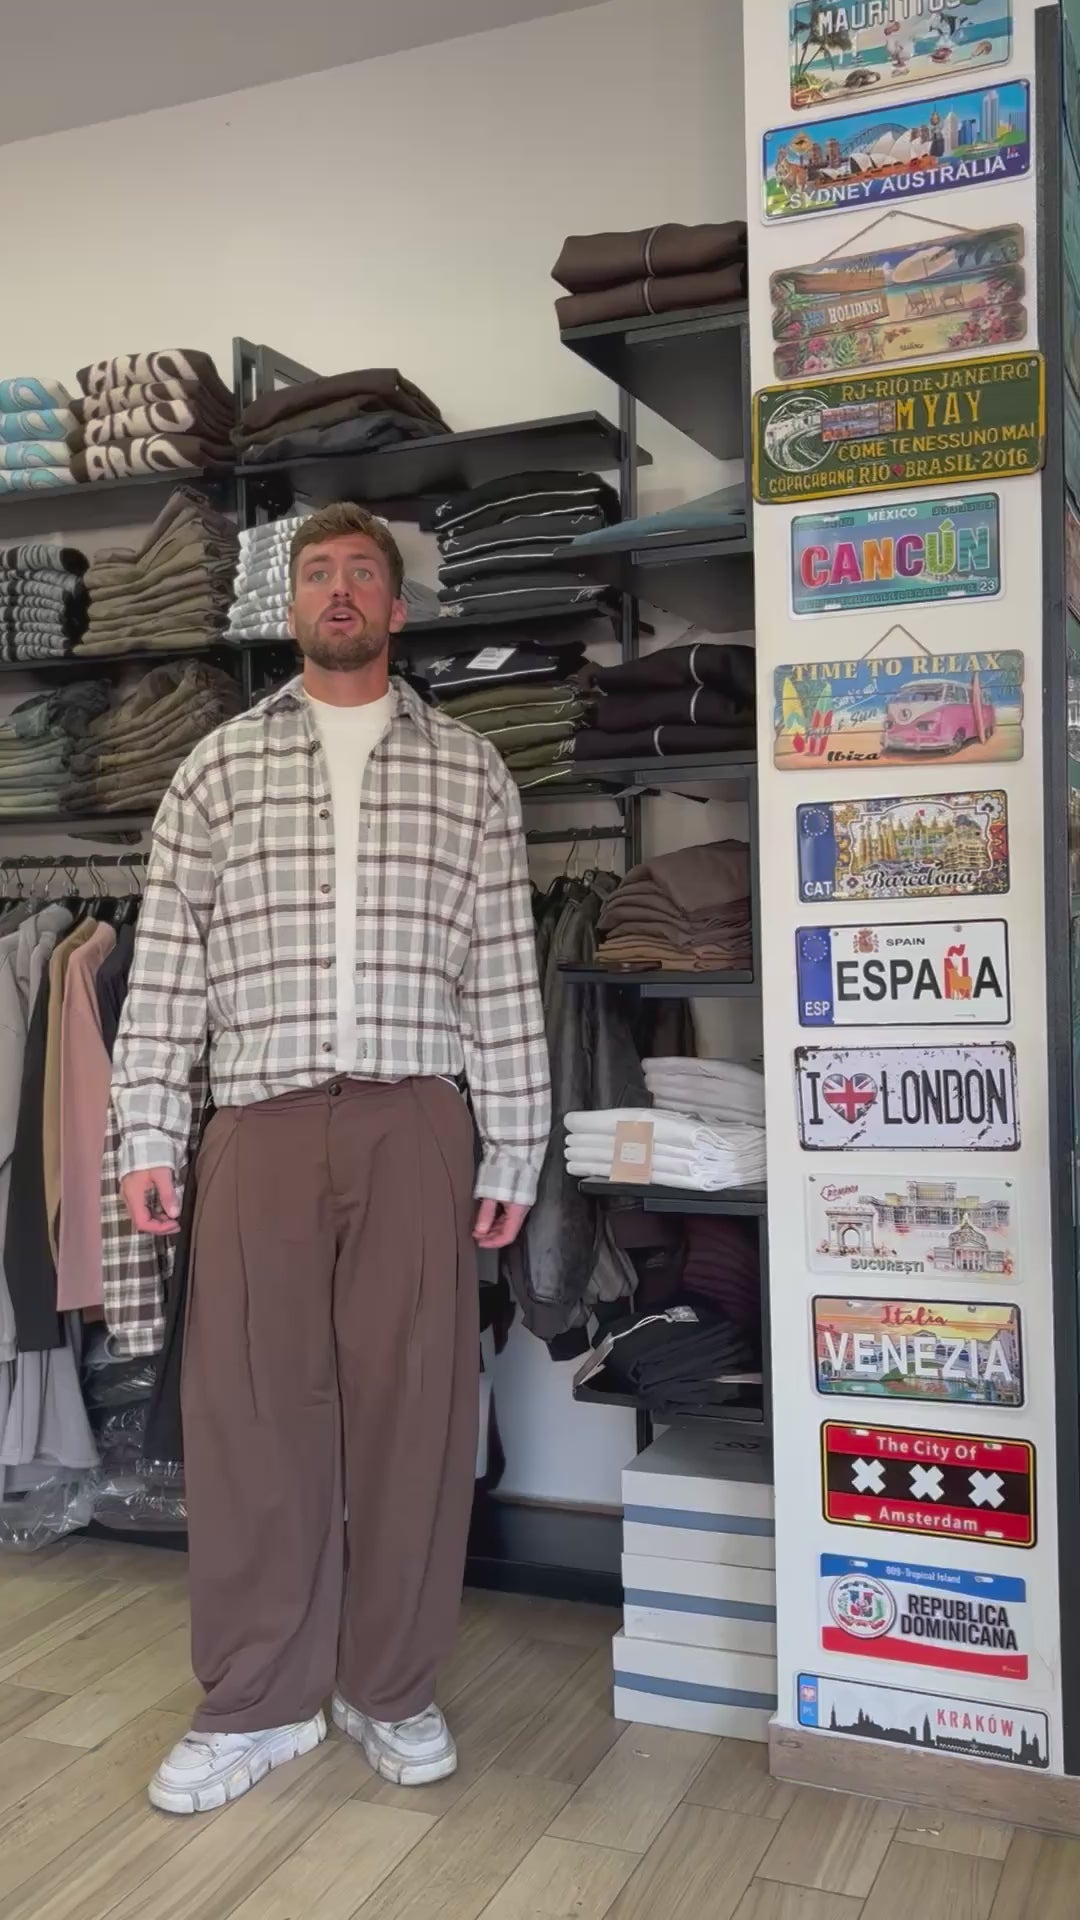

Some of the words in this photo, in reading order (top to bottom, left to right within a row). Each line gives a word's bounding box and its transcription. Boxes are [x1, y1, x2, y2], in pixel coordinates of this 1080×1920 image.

[788, 177, 880, 211] SYDNEY
[880, 155, 1007, 195] AUSTRALIA
[913, 379, 933, 391] DE
[935, 362, 1030, 390] JANEIRO
[896, 390, 982, 431] MYAY
[838, 439, 887, 463] COME
[1001, 422, 1035, 441] MAI
[768, 467, 854, 494] COPACABANA
[858, 464, 890, 485] RIO
[867, 507, 918, 523] MÉXICO
[800, 517, 991, 589] CANCÚN
[979, 579, 997, 593] 23
[792, 662, 858, 682] TIME
[867, 658, 903, 678] TO
[912, 652, 1002, 674] RELAX
[827, 751, 881, 762] Ibiza
[804, 880, 833, 896] CAT
[865, 871, 975, 889] Barcelona
[886, 937, 926, 947] SPAIN
[836, 944, 1004, 1001] ESPAÑA
[805, 1001, 831, 1017] ESP
[806, 1071, 824, 1125] I
[880, 1068, 1008, 1125] LONDON
[850, 1257, 925, 1275] BUCUREȘTI
[881, 1304, 949, 1326] Italia
[824, 1332, 1013, 1382] VENEZIA
[876, 1436, 909, 1454] The
[913, 1440, 950, 1462] City
[955, 1445, 977, 1460] Of
[879, 1506, 978, 1532] Amsterdam
[907, 1593, 1010, 1628] REPUBLICA
[901, 1613, 1019, 1651] DOMINICANA
[936, 1707, 1015, 1737] KRAKÓW
